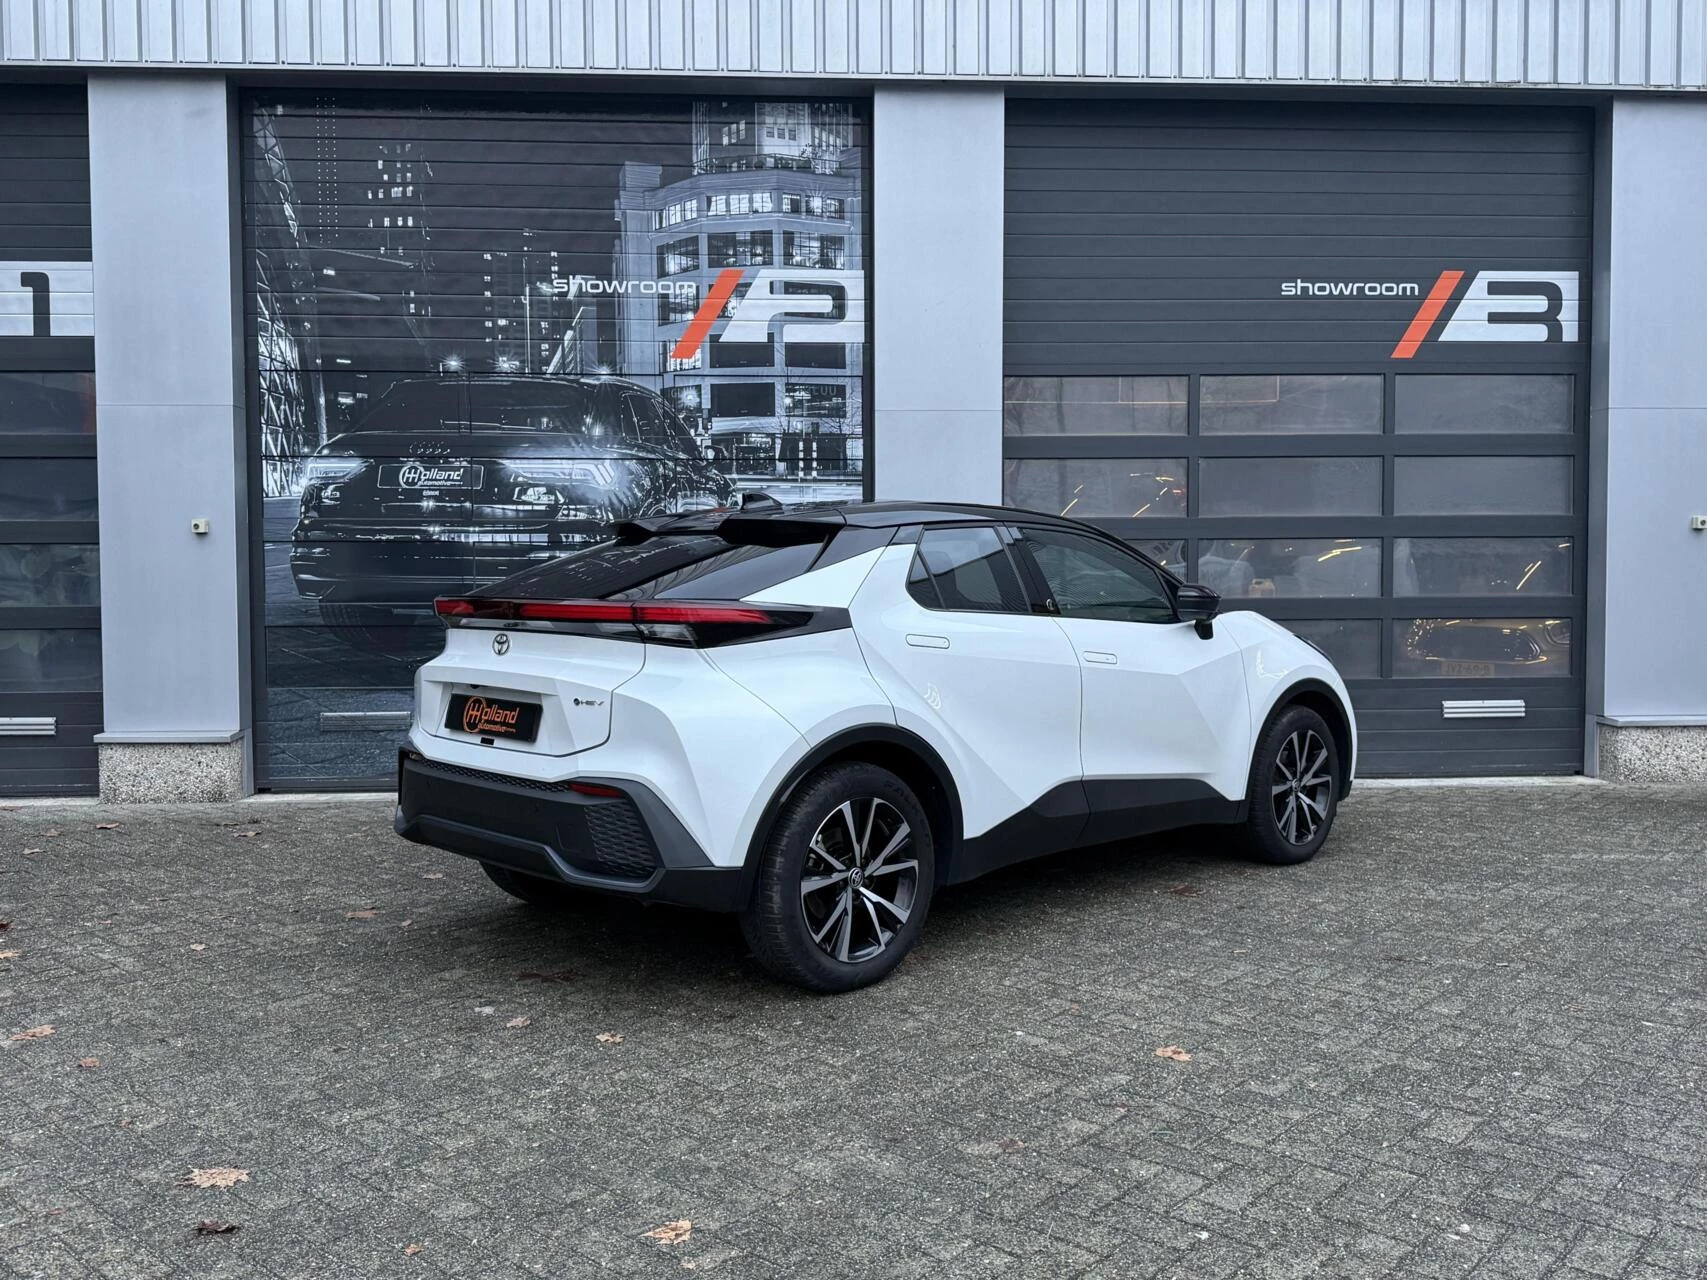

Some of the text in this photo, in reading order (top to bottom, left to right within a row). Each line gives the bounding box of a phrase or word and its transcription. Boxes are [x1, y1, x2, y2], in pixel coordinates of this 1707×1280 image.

[551, 275, 697, 295] showroom
[1280, 278, 1420, 297] showroom
[20, 271, 51, 336] 1
[401, 467, 464, 483] Holland
[465, 701, 520, 724] Holland
